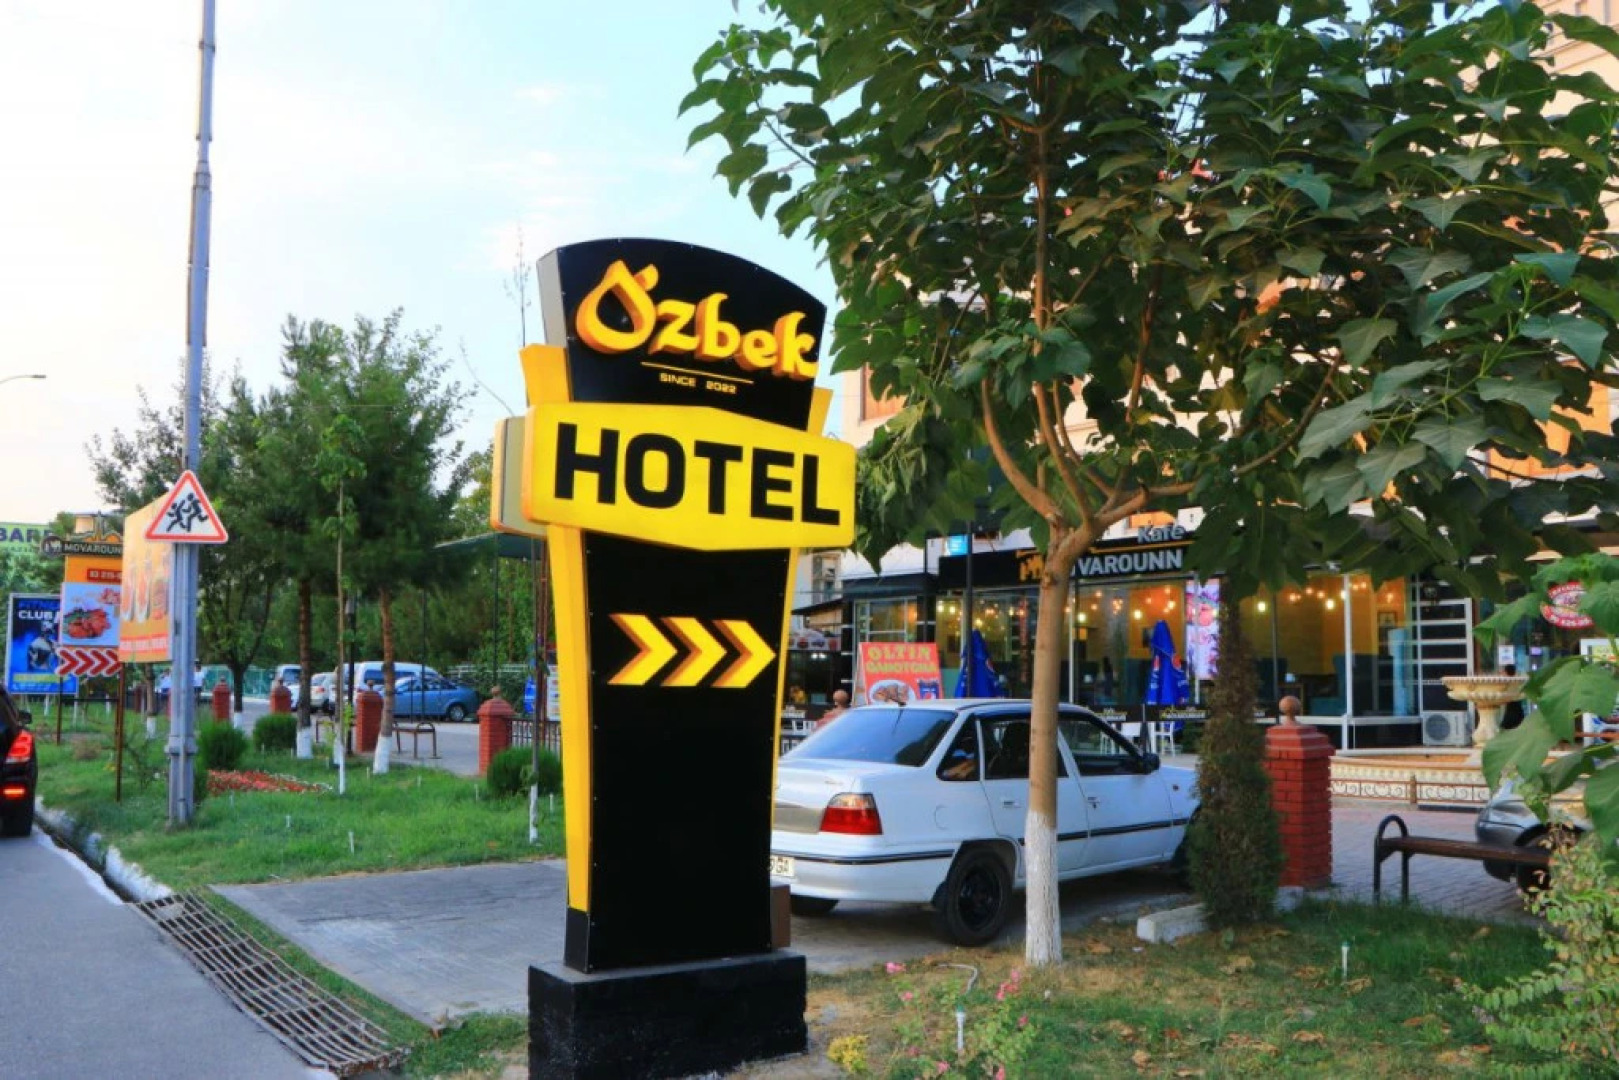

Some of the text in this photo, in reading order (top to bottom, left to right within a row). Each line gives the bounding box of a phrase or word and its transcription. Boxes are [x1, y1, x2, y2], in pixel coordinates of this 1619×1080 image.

[660, 372, 737, 395] SINCE 2022
[554, 422, 841, 527] HOTEL
[1137, 525, 1185, 544] Kafe
[18, 609, 53, 620] CLUB
